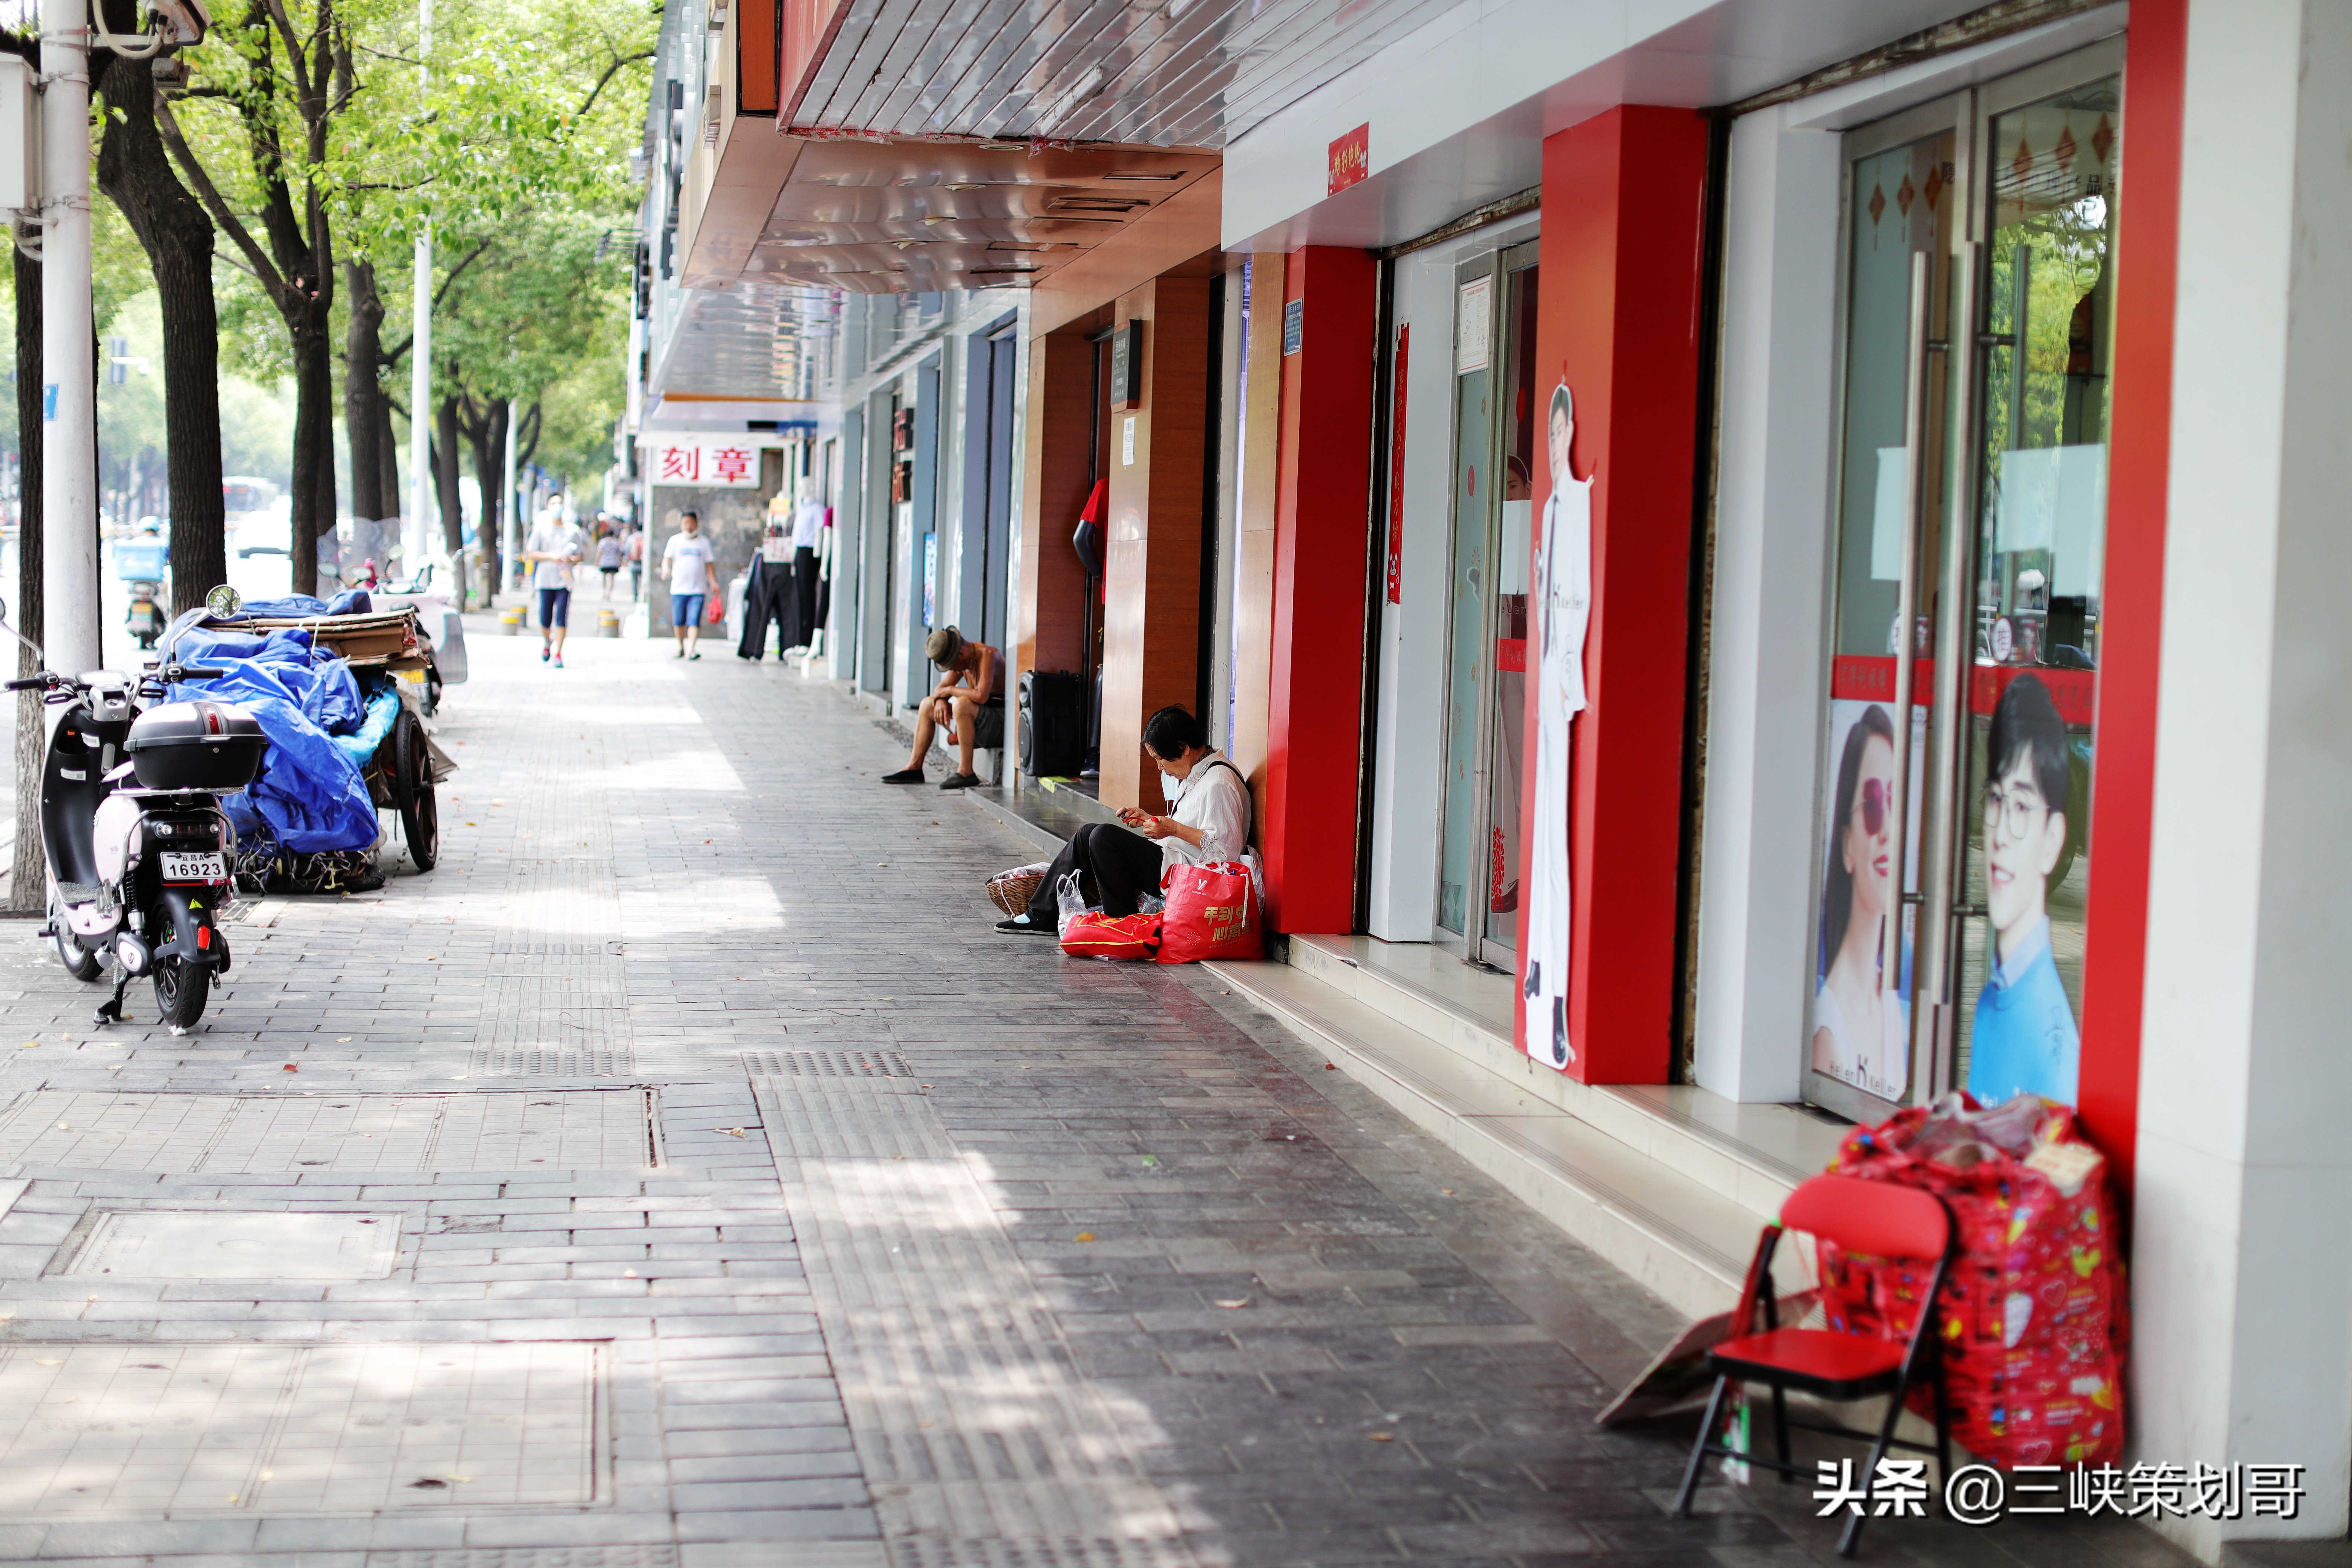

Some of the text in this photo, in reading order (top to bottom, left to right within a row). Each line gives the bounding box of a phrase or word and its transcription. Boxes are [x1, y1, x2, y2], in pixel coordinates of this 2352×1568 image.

[662, 446, 752, 482] 刻章
[169, 863, 221, 876] 16923
[1204, 906, 1234, 926] 年到
